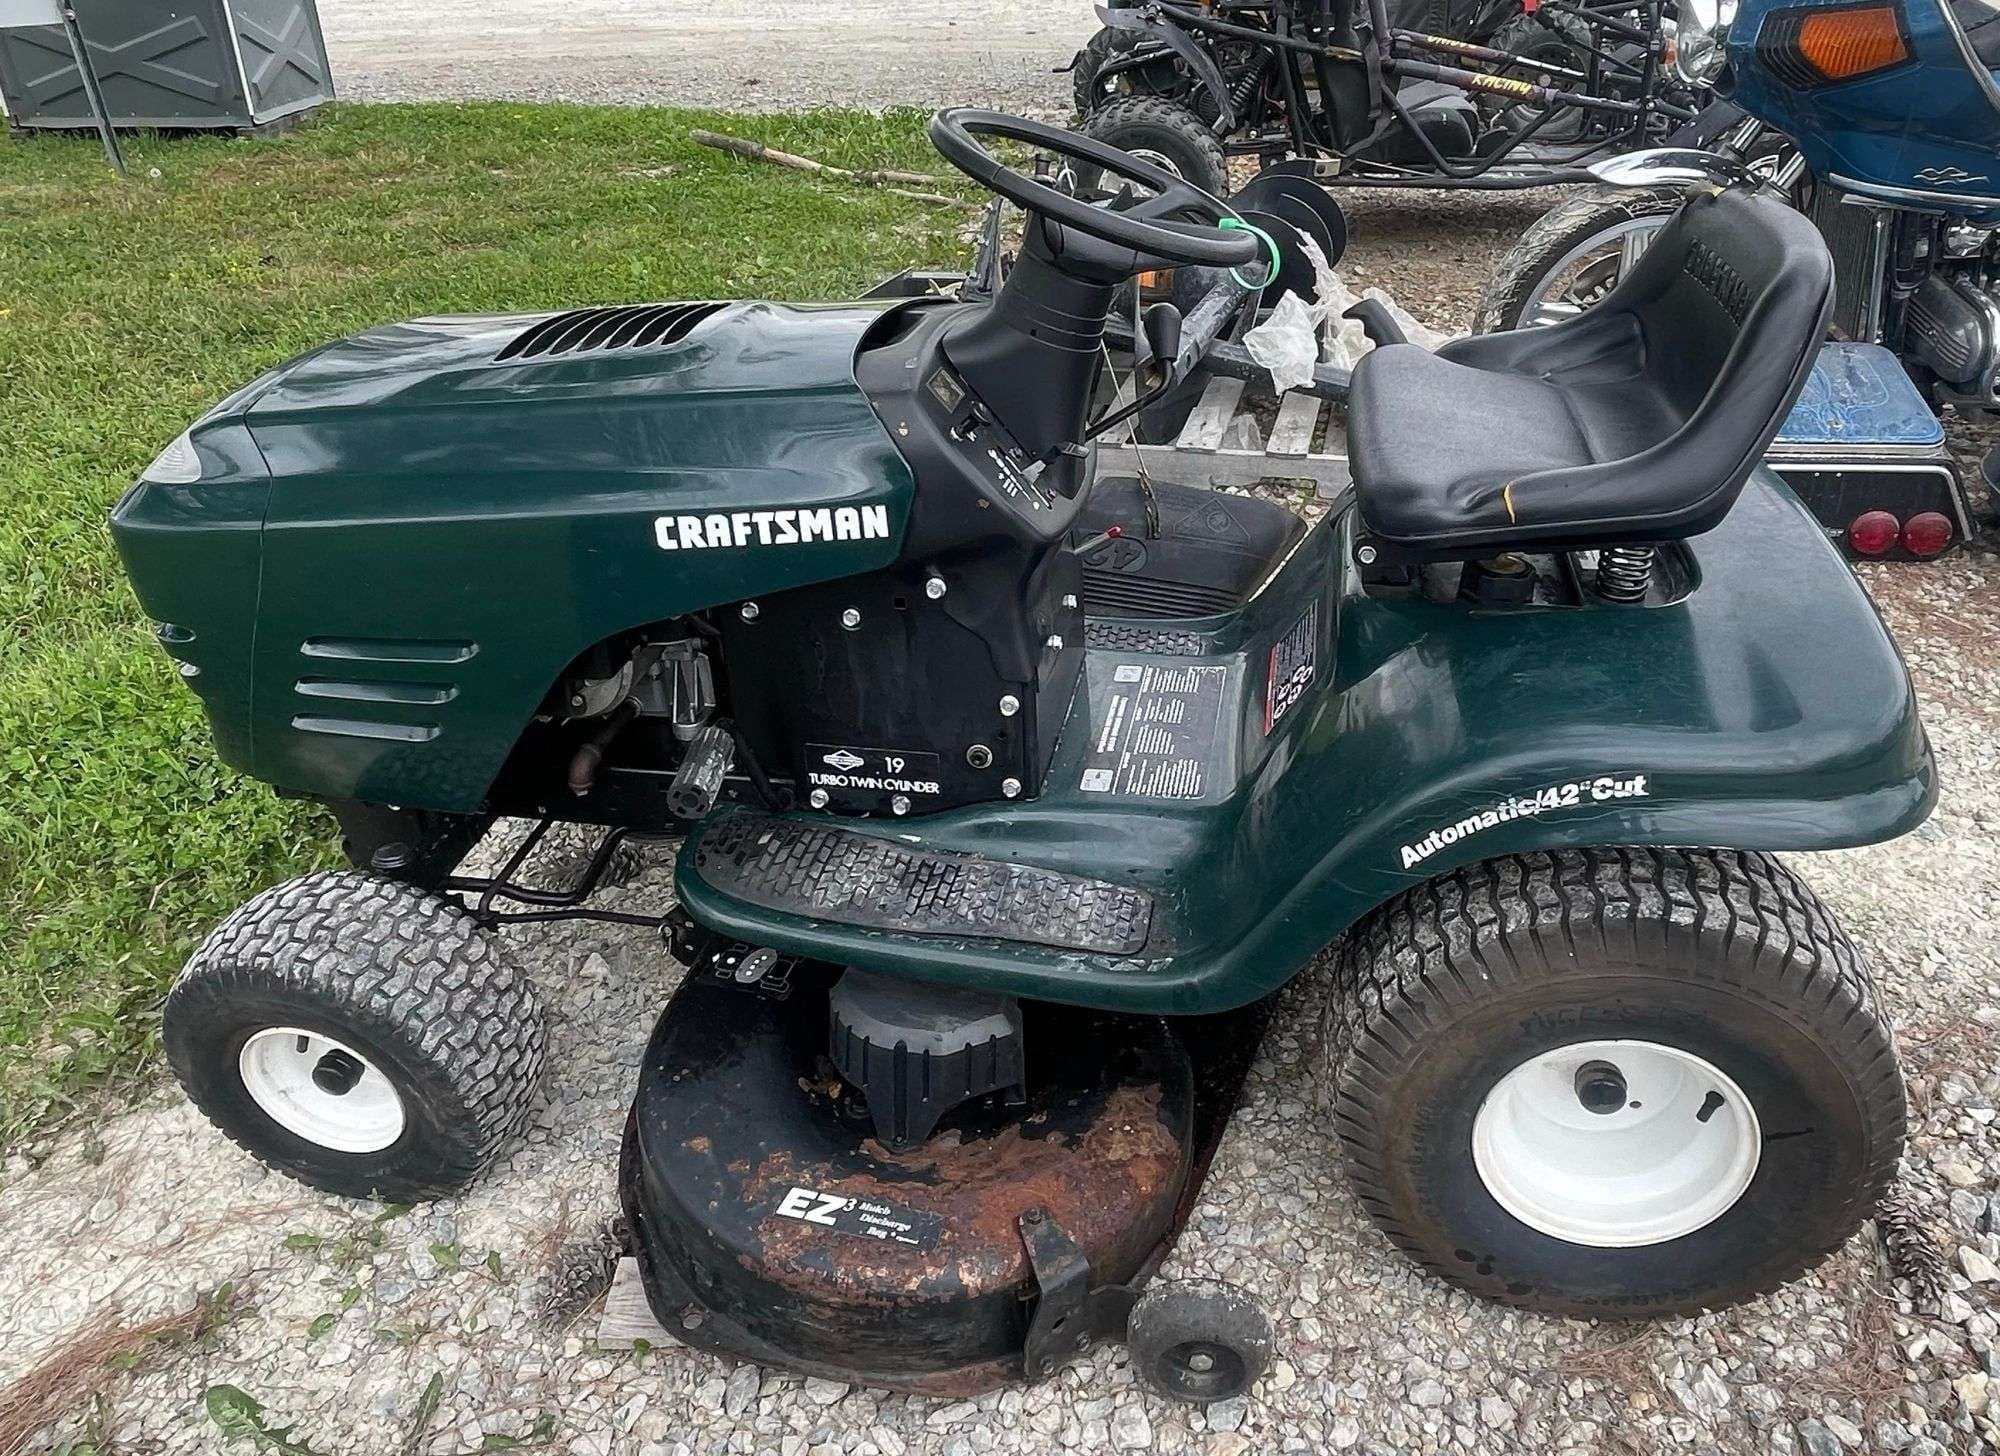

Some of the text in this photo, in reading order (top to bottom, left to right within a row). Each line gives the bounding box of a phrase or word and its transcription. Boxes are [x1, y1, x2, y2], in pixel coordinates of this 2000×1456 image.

[654, 505, 889, 550] CRAFTSMAN
[884, 757, 905, 774] 19
[808, 772, 940, 794] TURBO TWIN CYLINDER
[858, 1202, 892, 1216] Mulch
